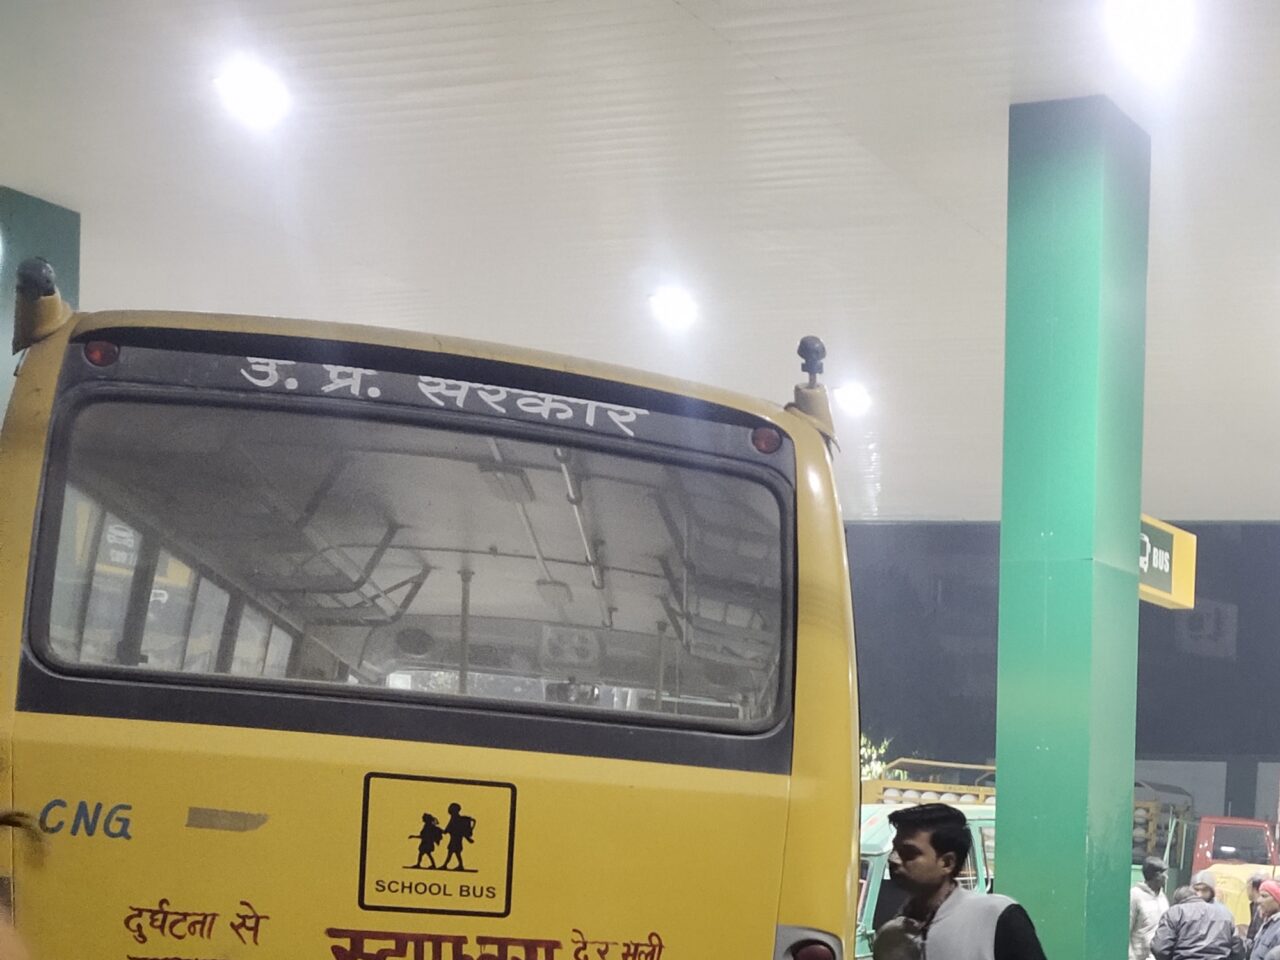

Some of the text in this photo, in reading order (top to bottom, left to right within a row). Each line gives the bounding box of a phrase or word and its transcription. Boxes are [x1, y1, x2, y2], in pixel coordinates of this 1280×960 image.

[241, 356, 650, 437] उ. प्र. सरकार
[1152, 546, 1170, 573] BUS
[39, 799, 132, 840] CNG
[375, 879, 497, 899] SCHOOL BUS
[123, 898, 270, 945] दुर्घटना से
